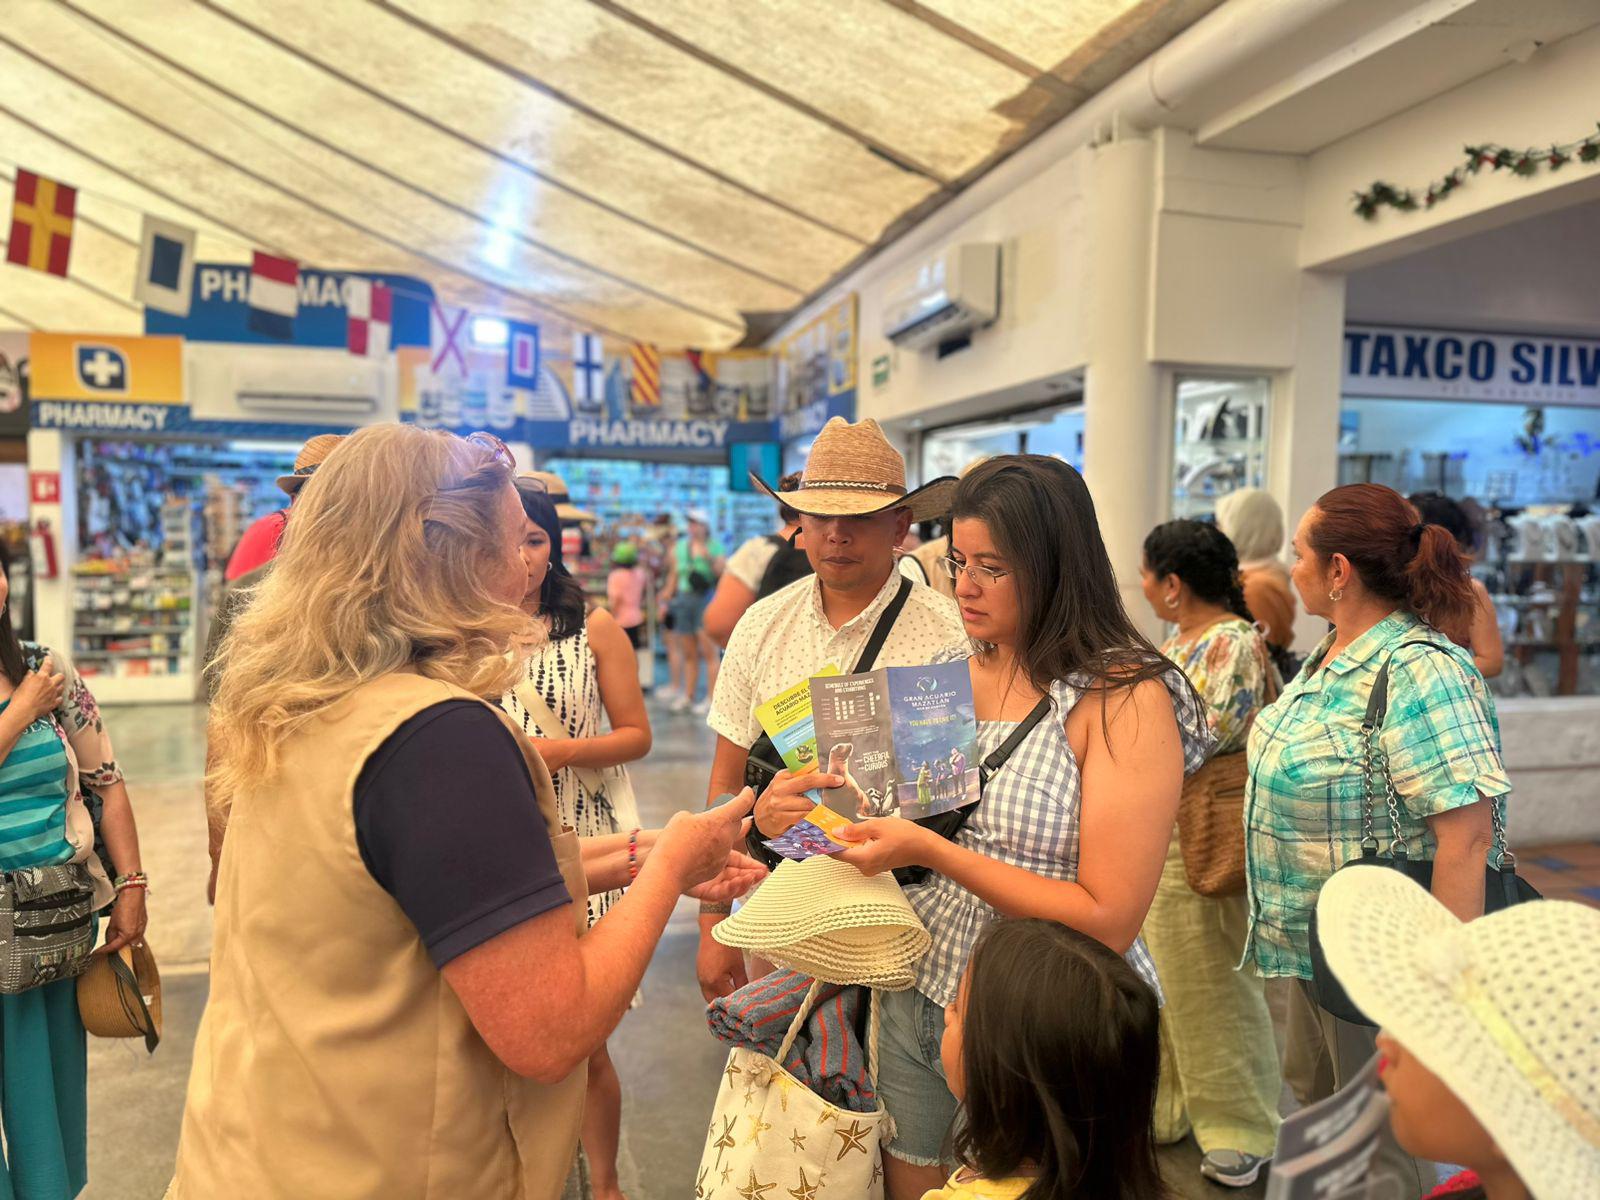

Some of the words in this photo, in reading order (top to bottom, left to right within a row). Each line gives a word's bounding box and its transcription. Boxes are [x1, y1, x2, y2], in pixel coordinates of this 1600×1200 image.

[1344, 331, 1496, 382] TAXCO
[39, 401, 169, 431] PHARMACY
[569, 418, 729, 447] PHARMACY
[773, 692, 801, 711] DESCUBRE
[924, 690, 957, 700] ACUARIO
[775, 699, 800, 716] ACUARIO
